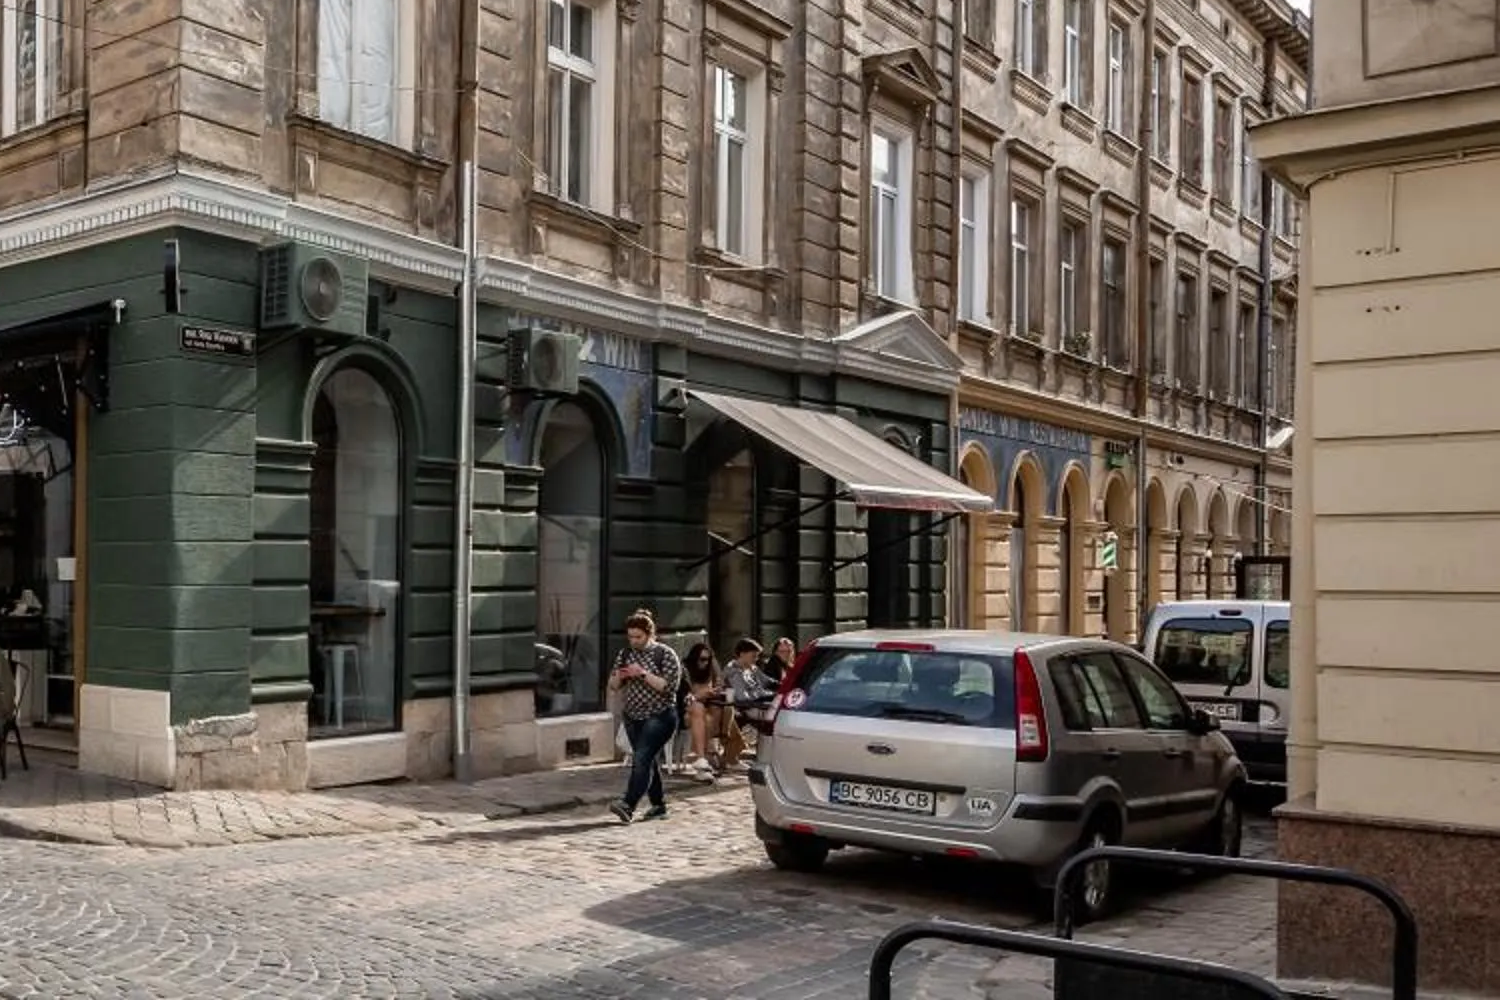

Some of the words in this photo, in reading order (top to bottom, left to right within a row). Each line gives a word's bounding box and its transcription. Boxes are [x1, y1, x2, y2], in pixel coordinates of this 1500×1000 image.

[842, 784, 861, 800] BC
[866, 787, 900, 805] 9056
[905, 793, 929, 809] CB
